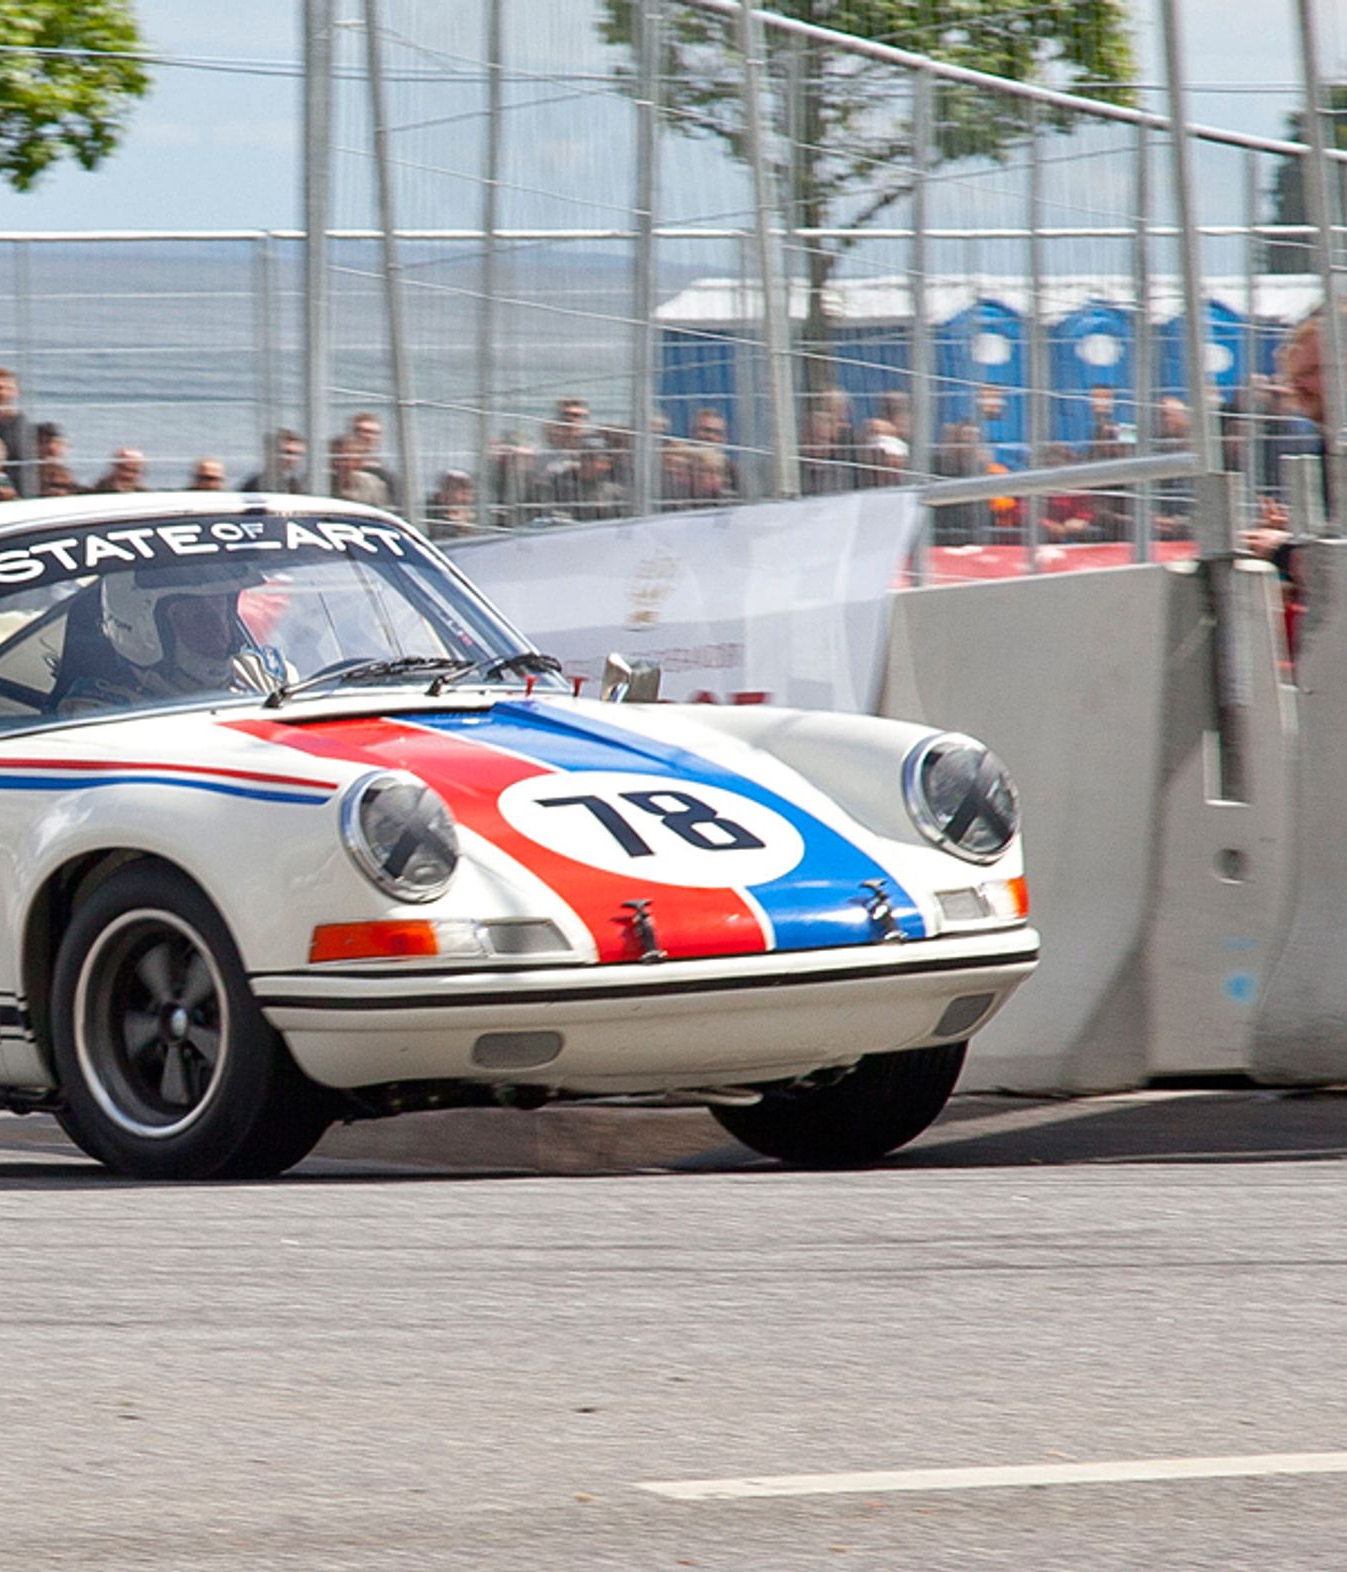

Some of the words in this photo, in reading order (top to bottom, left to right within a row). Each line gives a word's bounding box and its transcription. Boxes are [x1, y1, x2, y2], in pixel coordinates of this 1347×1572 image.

[210, 522, 264, 541] OF
[286, 521, 405, 557] ART
[532, 790, 766, 857] 78
